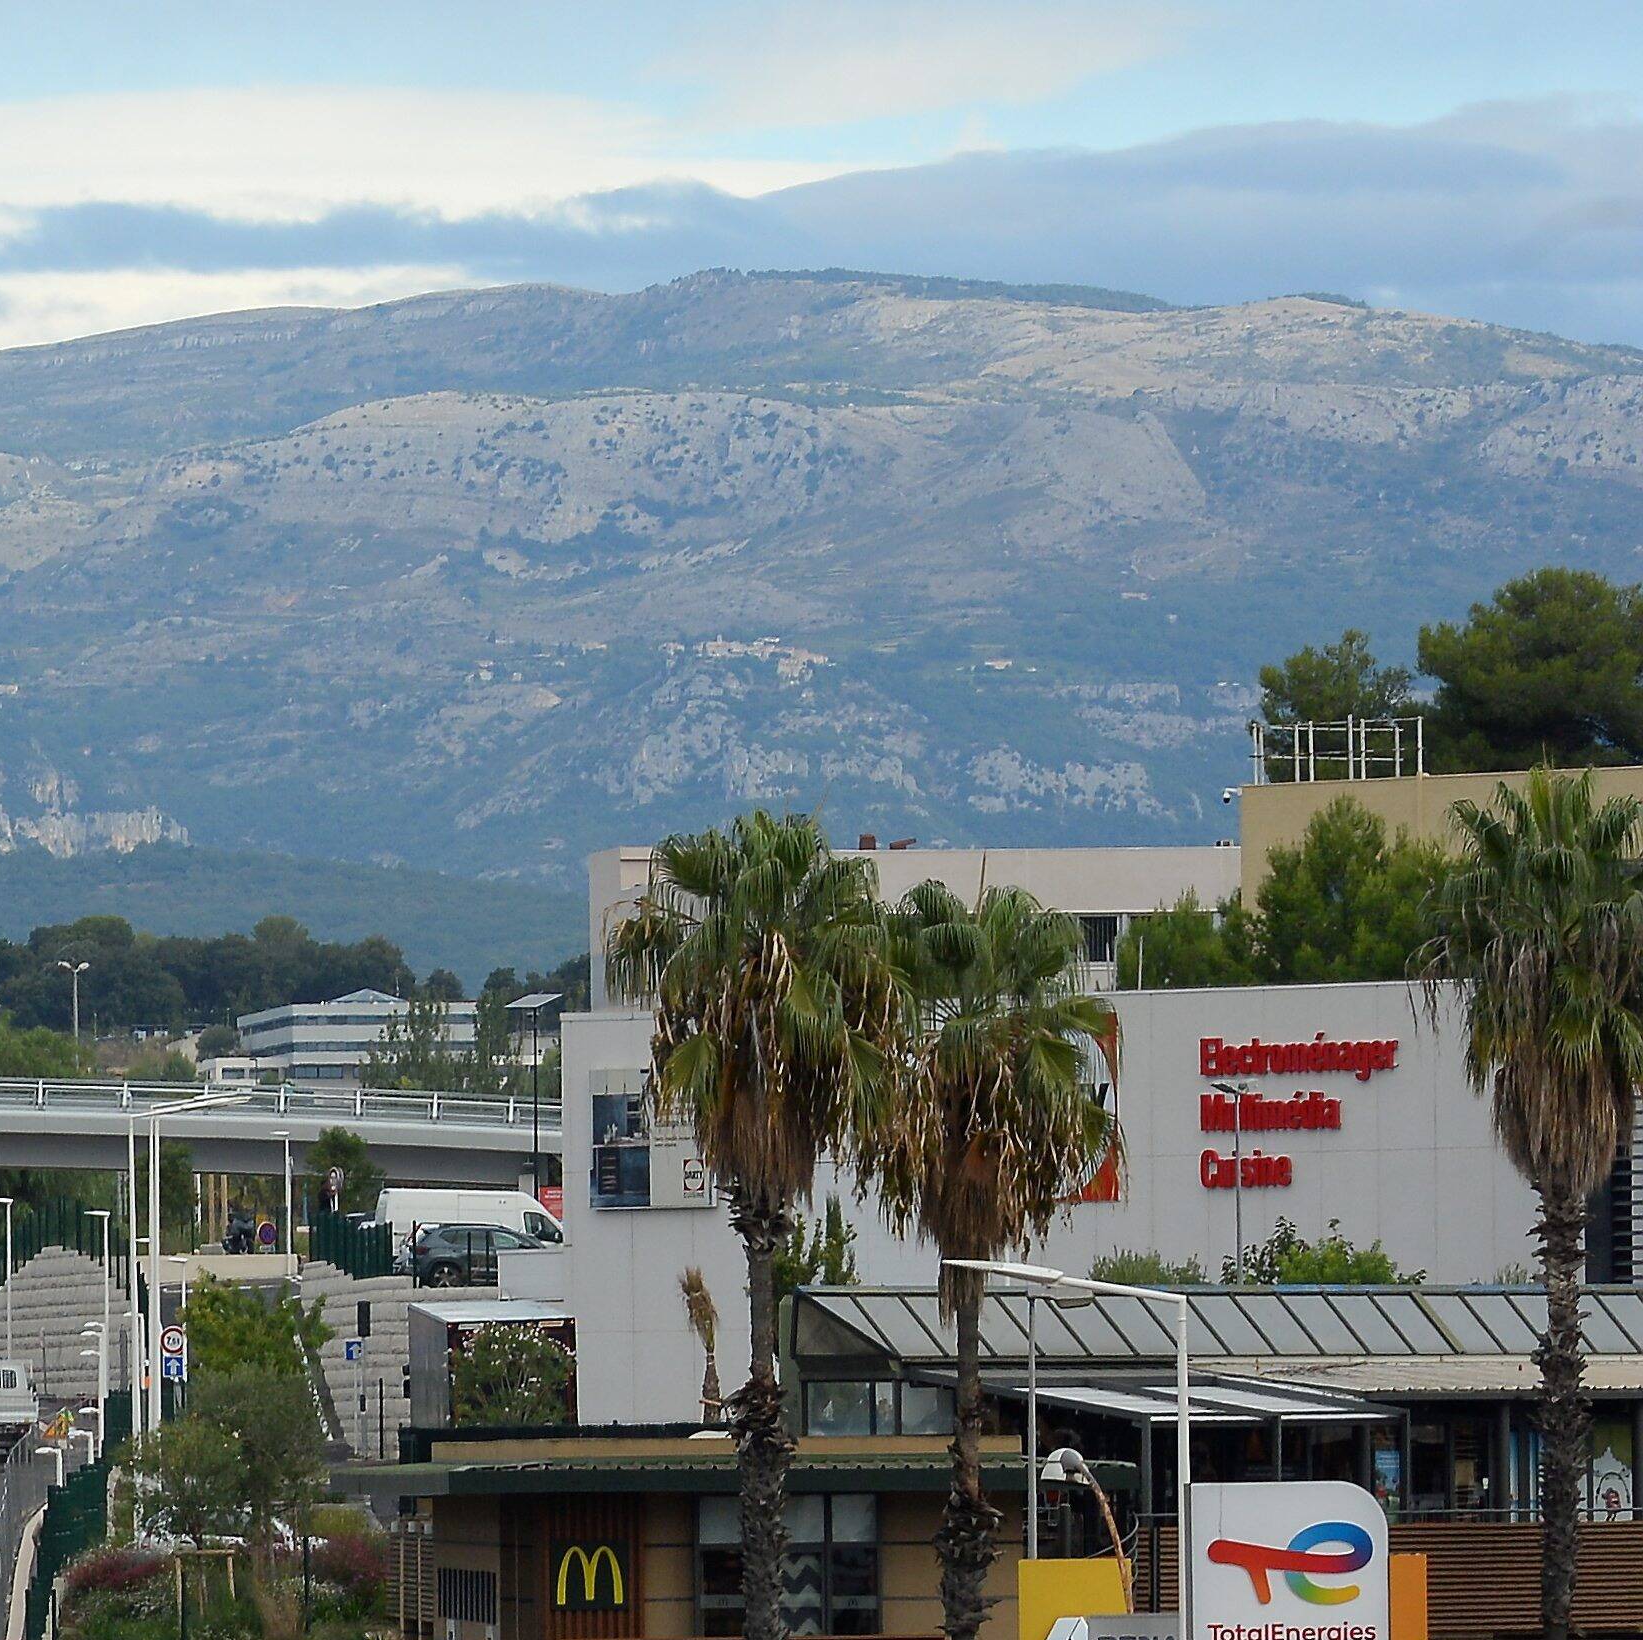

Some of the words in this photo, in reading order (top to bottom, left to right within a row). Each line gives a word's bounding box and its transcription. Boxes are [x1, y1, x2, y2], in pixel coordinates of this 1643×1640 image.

[1200, 1032, 1398, 1081] Electroménager
[1200, 1091, 1342, 1131] Multimédia
[1200, 1149, 1293, 1188] Cuisine
